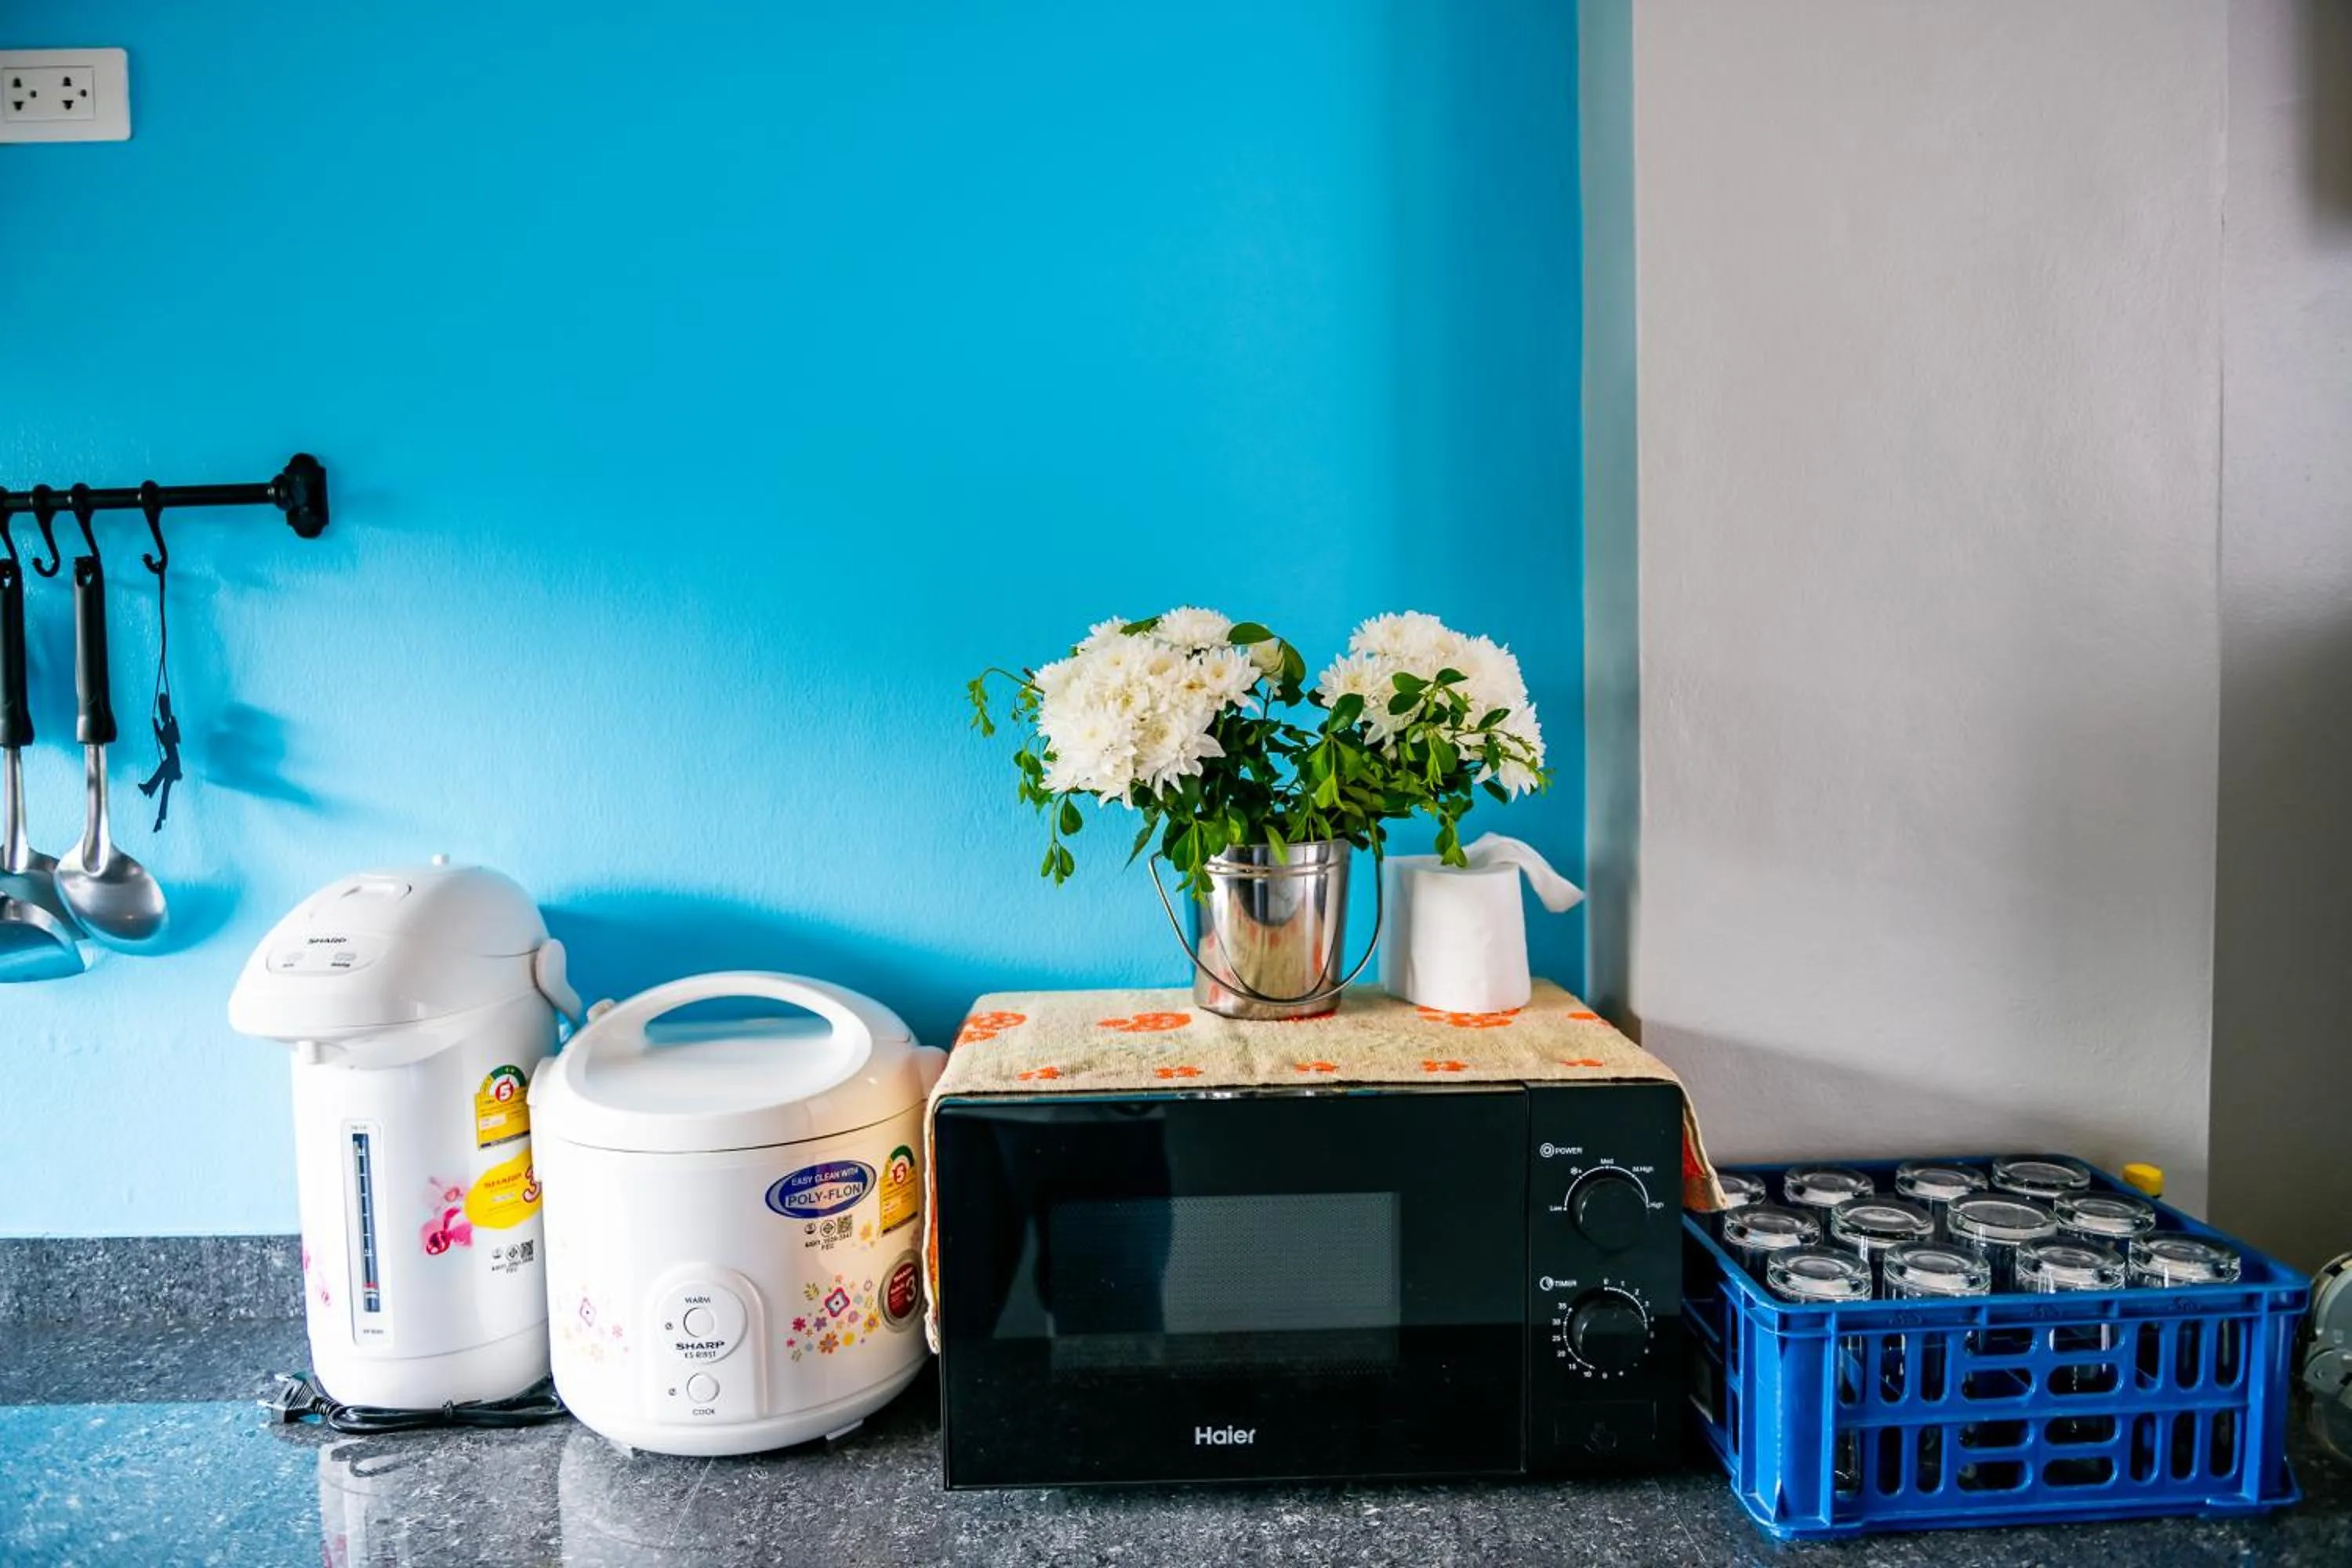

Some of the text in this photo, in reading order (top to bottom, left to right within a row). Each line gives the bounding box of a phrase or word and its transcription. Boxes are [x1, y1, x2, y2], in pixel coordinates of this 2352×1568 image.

[791, 1166, 858, 1185] EASY CLEAN WITH
[788, 1183, 861, 1207] POLY-FLON
[675, 1341, 725, 1350] SHARP
[1195, 1425, 1257, 1445] Haier
